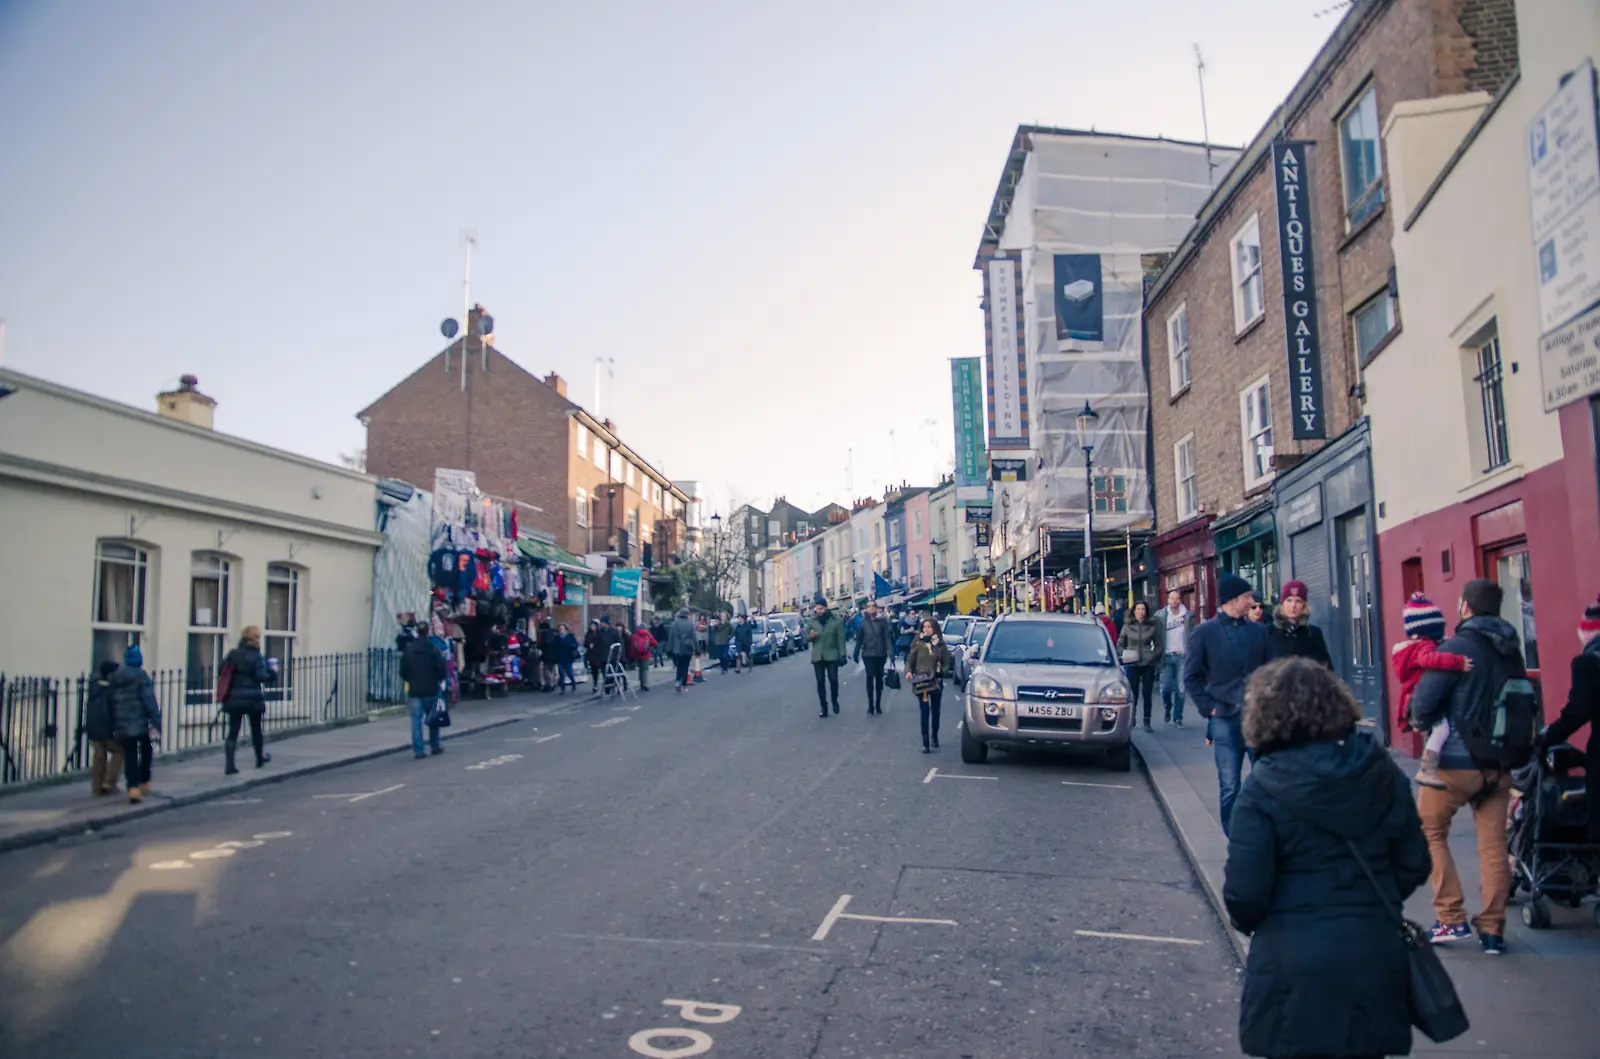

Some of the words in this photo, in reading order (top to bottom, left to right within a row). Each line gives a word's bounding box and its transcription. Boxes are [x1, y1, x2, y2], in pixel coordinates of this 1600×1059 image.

[1281, 148, 1305, 291] ANTIQUES
[999, 266, 1009, 333] STUMPER
[961, 364, 973, 429] HIGHLAND
[1002, 355, 1012, 430] FIELDING
[1292, 300, 1316, 431] GALLERY
[965, 434, 974, 476] STORE
[1055, 706, 1073, 717] ZBU
